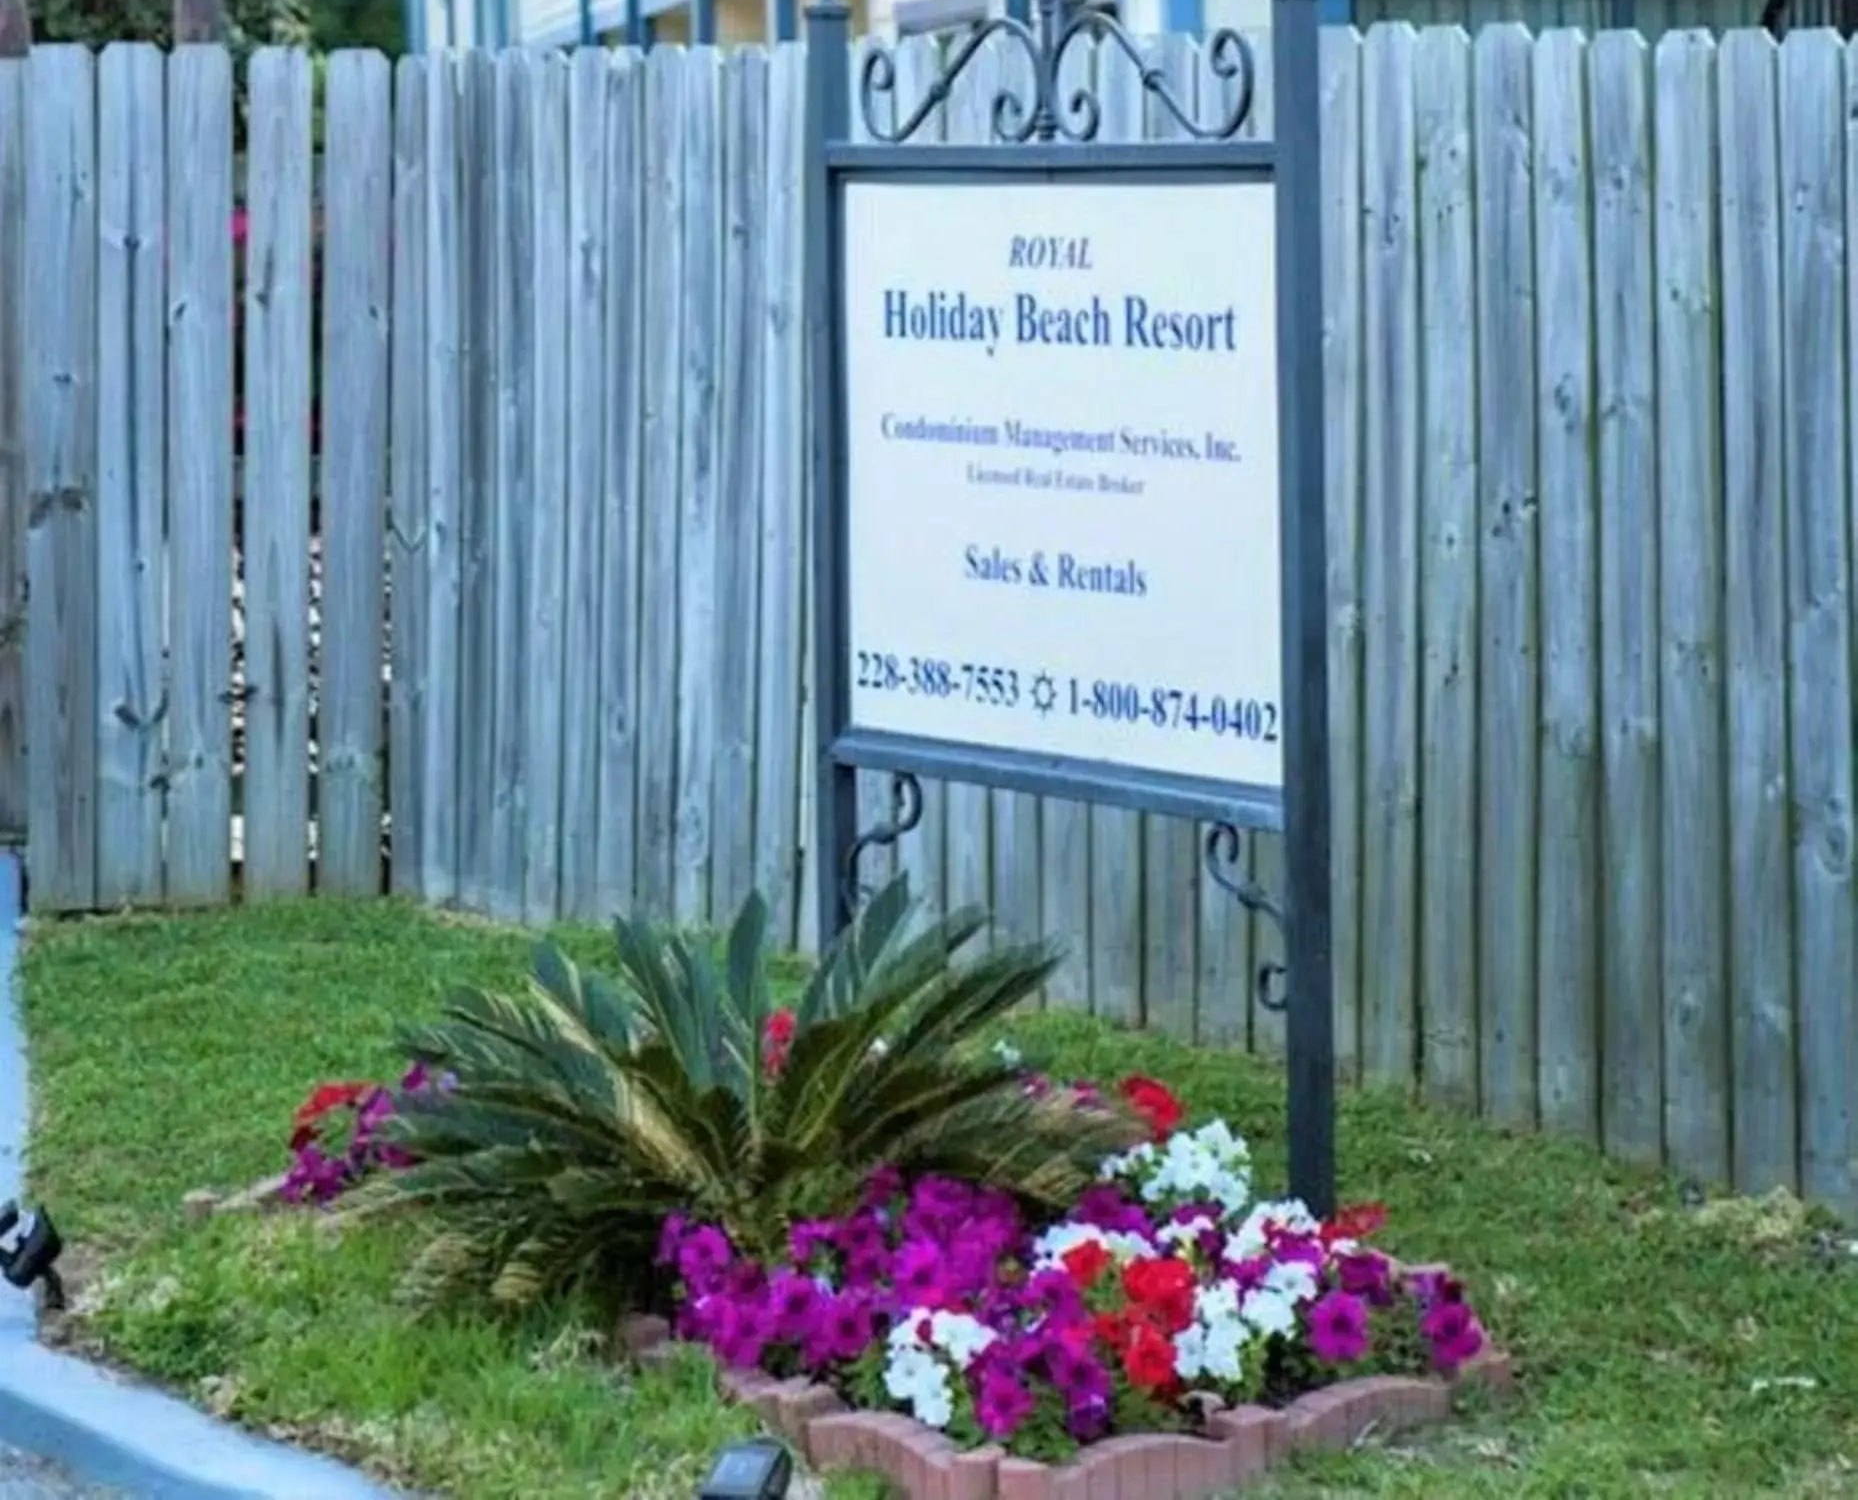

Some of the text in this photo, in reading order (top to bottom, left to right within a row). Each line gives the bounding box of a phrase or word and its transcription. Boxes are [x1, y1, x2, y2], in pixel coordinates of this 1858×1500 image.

[1008, 235, 1093, 270] ROYAL
[883, 289, 1237, 357] Holiday Beach Resort
[881, 412, 999, 445] Condominium
[1003, 419, 1115, 453] Management
[1205, 432, 1241, 462] Inc.
[965, 544, 1147, 597] Sales & Rentals
[857, 650, 1278, 743] 228-388-7553 1-800-874-0402
